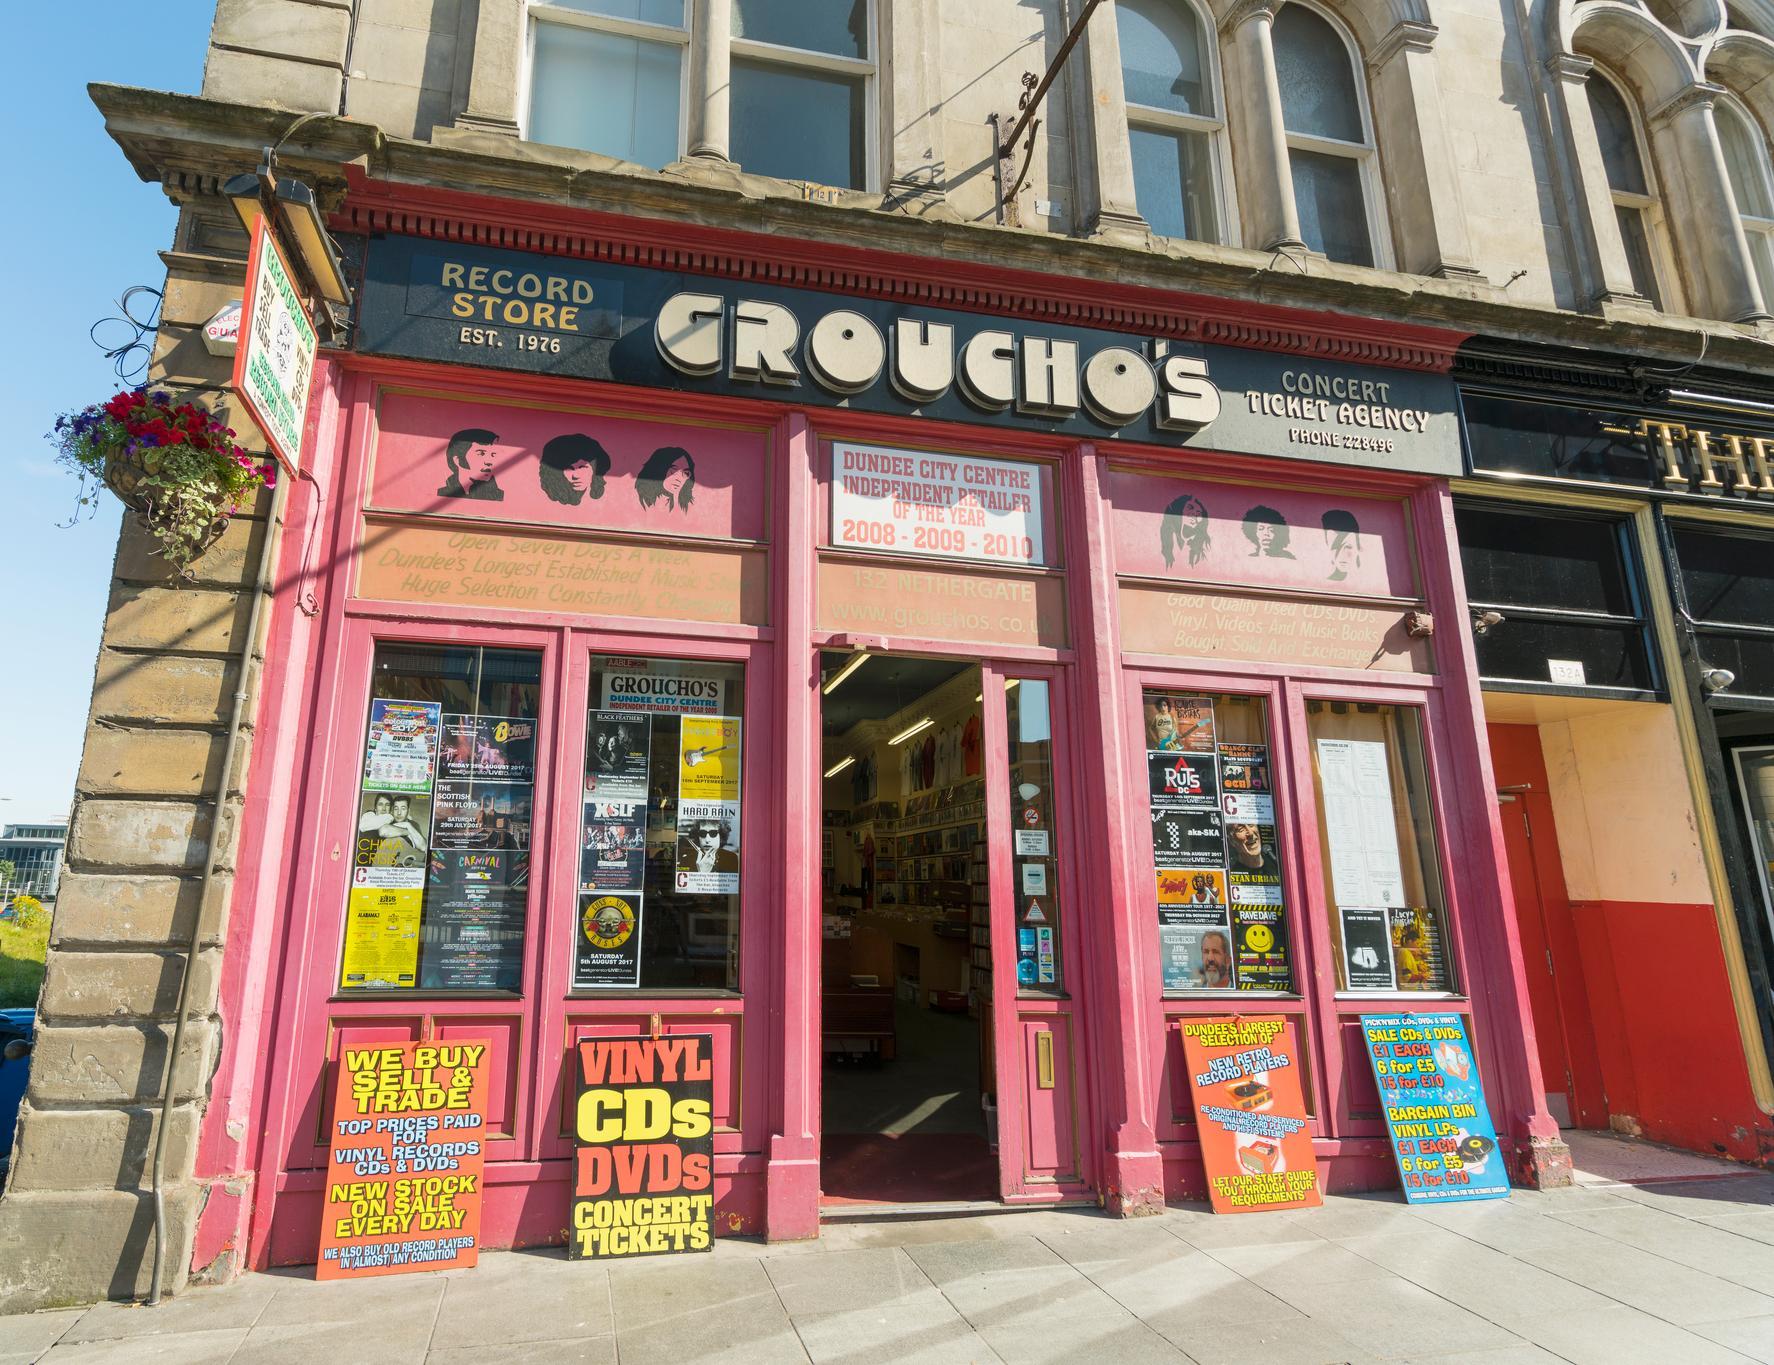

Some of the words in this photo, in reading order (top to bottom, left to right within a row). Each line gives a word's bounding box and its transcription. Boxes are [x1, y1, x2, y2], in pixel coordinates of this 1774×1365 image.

[262, 272, 275, 306] BUY
[442, 262, 594, 304] RECORD
[258, 294, 271, 331] SELL
[452, 292, 580, 331] STORE
[254, 314, 271, 355] TRADE
[460, 327, 503, 348] EST.
[517, 334, 562, 354] 1976
[654, 291, 1222, 433] GROUCHO'S
[1281, 370, 1391, 404] CONCERT
[1244, 390, 1331, 422] TICKET
[1337, 402, 1431, 433] AGENCY
[1289, 428, 1340, 447] PHONE
[1342, 434, 1395, 453] 228496
[843, 450, 914, 477] DUNDEE
[919, 459, 958, 481] CITY
[963, 464, 1031, 490] CENTRE
[843, 475, 954, 504] INDEPENDENT
[958, 487, 1032, 513] RETAILER
[892, 501, 911, 519] OF
[917, 503, 945, 523] THE
[949, 506, 986, 527] YEAR
[448, 533, 500, 551] Open
[504, 536, 566, 556] Seven
[574, 542, 622, 563] Days
[853, 569, 888, 590] 132
[897, 573, 1033, 602] NETHERGATE
[1553, 666, 1581, 679] 132A
[611, 676, 718, 698] GROUCHO'S
[610, 694, 652, 703] DUNDEE
[655, 697, 677, 705] CITY
[679, 698, 718, 707] CENTRE
[494, 721, 532, 743] BOWIE
[455, 801, 478, 809] FLOYD
[683, 807, 709, 816] HARD
[711, 808, 736, 817] RAIN
[1187, 828, 1220, 837] aka-SKA
[358, 838, 403, 851] CHINA
[357, 852, 398, 866] CRISIS
[458, 855, 500, 868] CARNIVAL
[1230, 874, 1251, 883] STAN
[1251, 875, 1280, 883] URBAN
[1239, 910, 1259, 920] RAVE
[1259, 911, 1277, 921] DAVE
[1184, 1022, 1238, 1036] DUNDEE'S
[1239, 1021, 1284, 1034] LARGEST
[1200, 1033, 1258, 1047] SELECTION
[1260, 1032, 1274, 1044] OF
[1367, 1029, 1398, 1042] SALE
[1400, 1028, 1423, 1041] CDs
[1424, 1027, 1433, 1040] &
[1434, 1026, 1463, 1040] DVDs
[346, 1048, 404, 1072] WE
[413, 1045, 485, 1069] BUY
[1208, 1055, 1235, 1072] NEW
[1235, 1046, 1272, 1065] RETRO
[1373, 1044, 1390, 1057] £1
[1393, 1043, 1432, 1057] EACH
[579, 1039, 712, 1085] VINYL
[1195, 1066, 1242, 1087] RECORD
[1242, 1054, 1290, 1076] PLAYERS
[1376, 1060, 1388, 1075] 6
[1390, 1059, 1414, 1074] for
[1416, 1058, 1436, 1073] £5
[352, 1068, 442, 1093] SELL
[450, 1066, 474, 1088] &
[1380, 1075, 1397, 1090] 15
[1398, 1075, 1418, 1089] for
[1420, 1074, 1445, 1088] £10
[352, 1087, 471, 1114] TRADE
[338, 1120, 372, 1135] TOP
[376, 1116, 439, 1133] PRICES
[443, 1113, 483, 1129] PAID
[577, 1088, 711, 1143] CDs
[1208, 1113, 1240, 1125] ORIGINAL
[1240, 1118, 1269, 1129] RECORD
[1269, 1122, 1299, 1134] PLAYERS
[1387, 1106, 1450, 1122] BARGAIN
[1451, 1103, 1477, 1119] BIN
[392, 1130, 427, 1145] FOR
[1393, 1123, 1433, 1138] VINYL
[1435, 1122, 1460, 1136] LPs
[335, 1147, 387, 1164] VINYL
[391, 1141, 480, 1160] RECORDS
[1398, 1141, 1416, 1155] £1
[1418, 1138, 1458, 1154] EACH
[354, 1161, 391, 1176] CDs
[395, 1160, 408, 1173] &
[413, 1156, 459, 1172] DVDs
[575, 1143, 711, 1197] DVDs
[1401, 1157, 1413, 1172] 6
[1415, 1157, 1440, 1171] for
[1444, 1155, 1464, 1169] £5
[330, 1180, 388, 1203] NEW
[394, 1175, 478, 1198] STOCK
[1212, 1176, 1230, 1187] LET
[1232, 1175, 1253, 1186] OUR
[1254, 1172, 1285, 1184] STAFF
[1286, 1170, 1316, 1181] GUIDE
[1218, 1186, 1239, 1197] YOU
[1240, 1182, 1286, 1195] THROUGH
[1287, 1180, 1314, 1191] YOUR
[1405, 1173, 1422, 1188] 15
[1422, 1173, 1444, 1187] for
[1446, 1171, 1470, 1185] £10
[351, 1199, 387, 1219] ON
[394, 1194, 454, 1217] SALE
[1230, 1190, 1306, 1207] REQUIREMENTS
[335, 1213, 415, 1238] EVERY
[419, 1209, 466, 1231] DAY
[574, 1194, 713, 1230] CONCERT
[324, 1247, 339, 1259] WE
[340, 1246, 362, 1258] ALSO
[364, 1245, 382, 1256] BUY
[383, 1243, 400, 1254] OLD
[401, 1240, 436, 1253] RECORD
[438, 1236, 475, 1249] PLAYERS
[576, 1221, 710, 1257] TICKETS
[340, 1256, 350, 1269] IN
[352, 1254, 391, 1270] (ALMOST)
[392, 1251, 410, 1264] ANY
[411, 1247, 458, 1263] CONDITION
